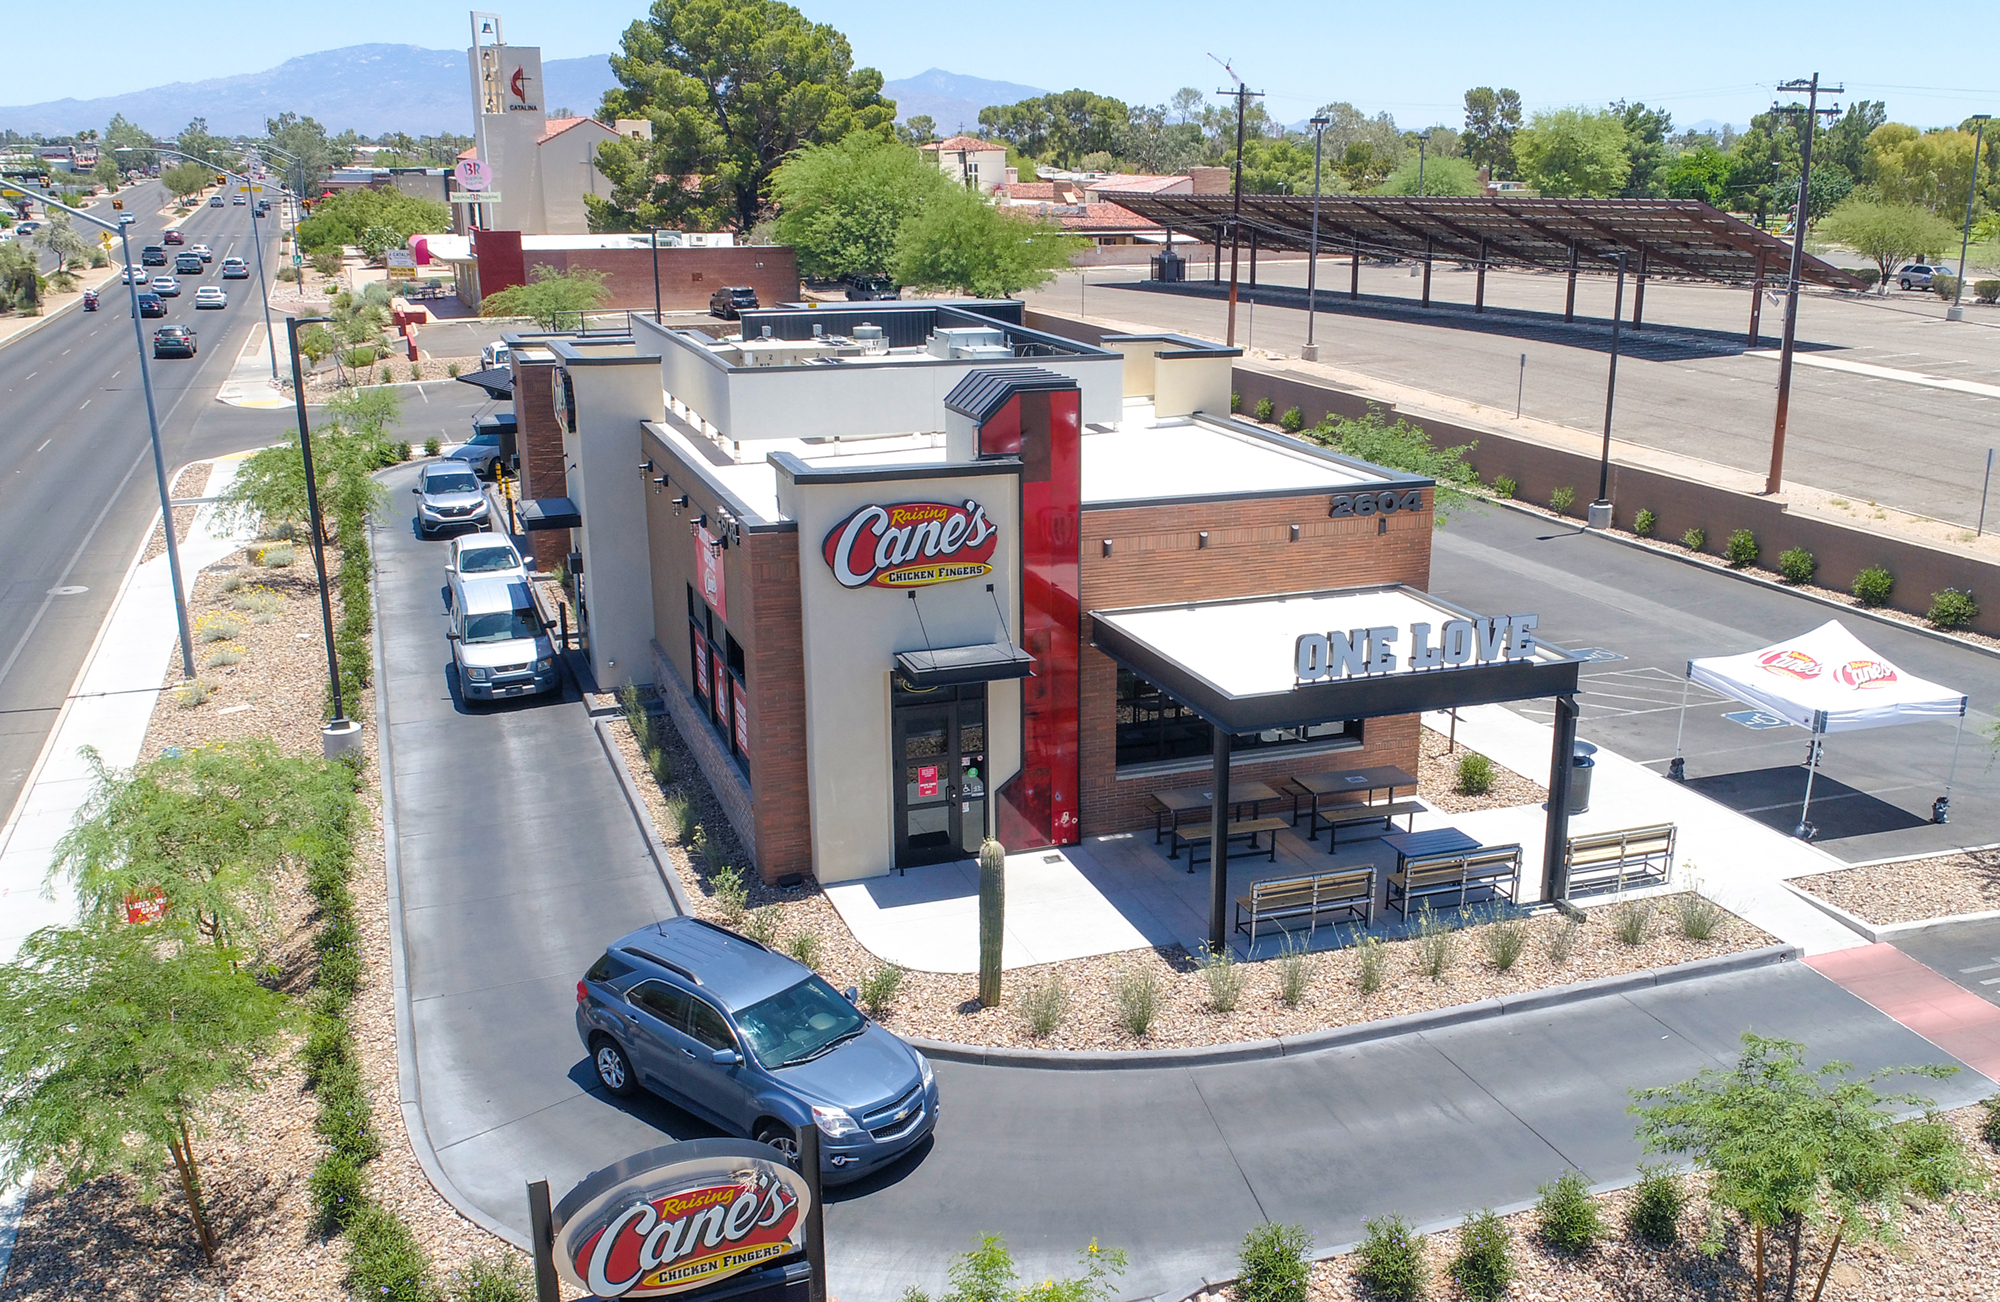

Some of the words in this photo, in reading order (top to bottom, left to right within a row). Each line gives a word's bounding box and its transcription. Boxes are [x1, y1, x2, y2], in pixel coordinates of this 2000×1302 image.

[463, 162, 481, 175] BR
[891, 506, 948, 526] Raising
[1328, 490, 1424, 518] 2604
[833, 499, 998, 587] Cane's
[1294, 625, 1398, 680] ONE
[1408, 613, 1539, 669] LOVE
[661, 1188, 735, 1218] Raising
[588, 1174, 799, 1298] Cane's
